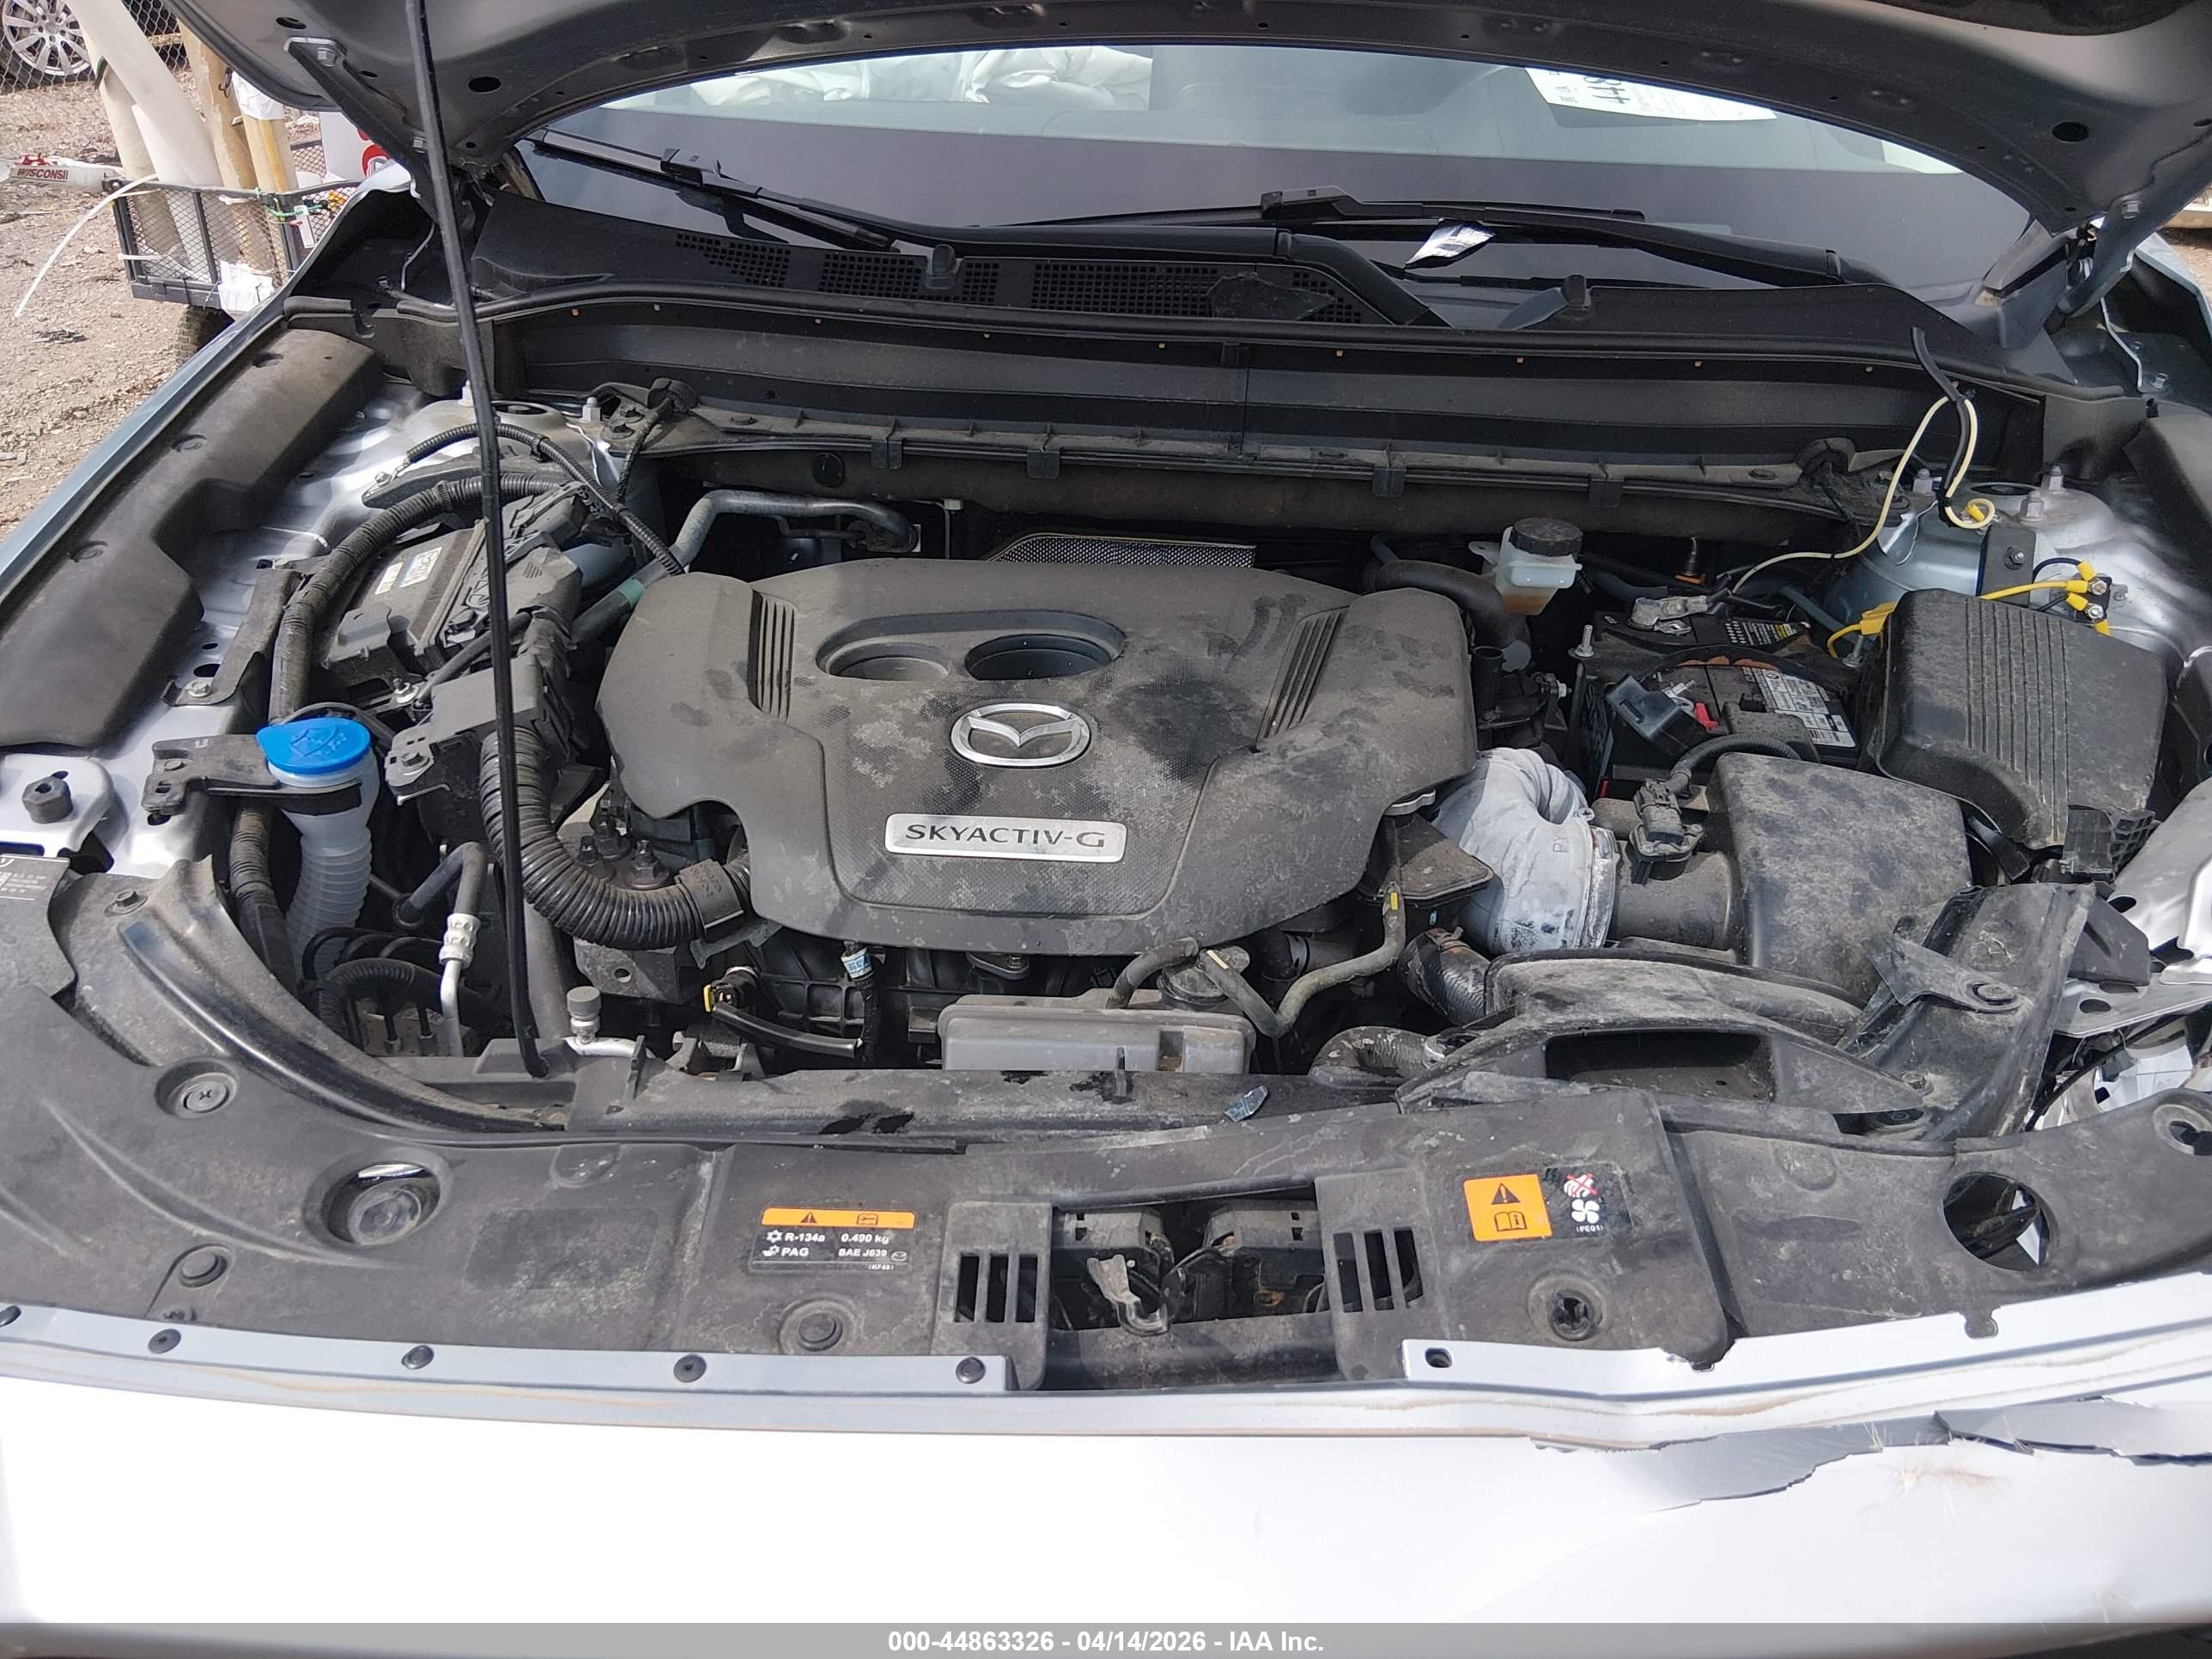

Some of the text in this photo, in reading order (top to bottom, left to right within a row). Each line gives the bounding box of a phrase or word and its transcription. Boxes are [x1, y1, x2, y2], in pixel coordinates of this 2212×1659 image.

[904, 823, 1106, 848] SKYACTIV-G
[784, 1232, 826, 1243] R-134a
[874, 1233, 890, 1245] kg
[781, 1247, 810, 1257] PAG
[837, 1248, 861, 1258] SAE
